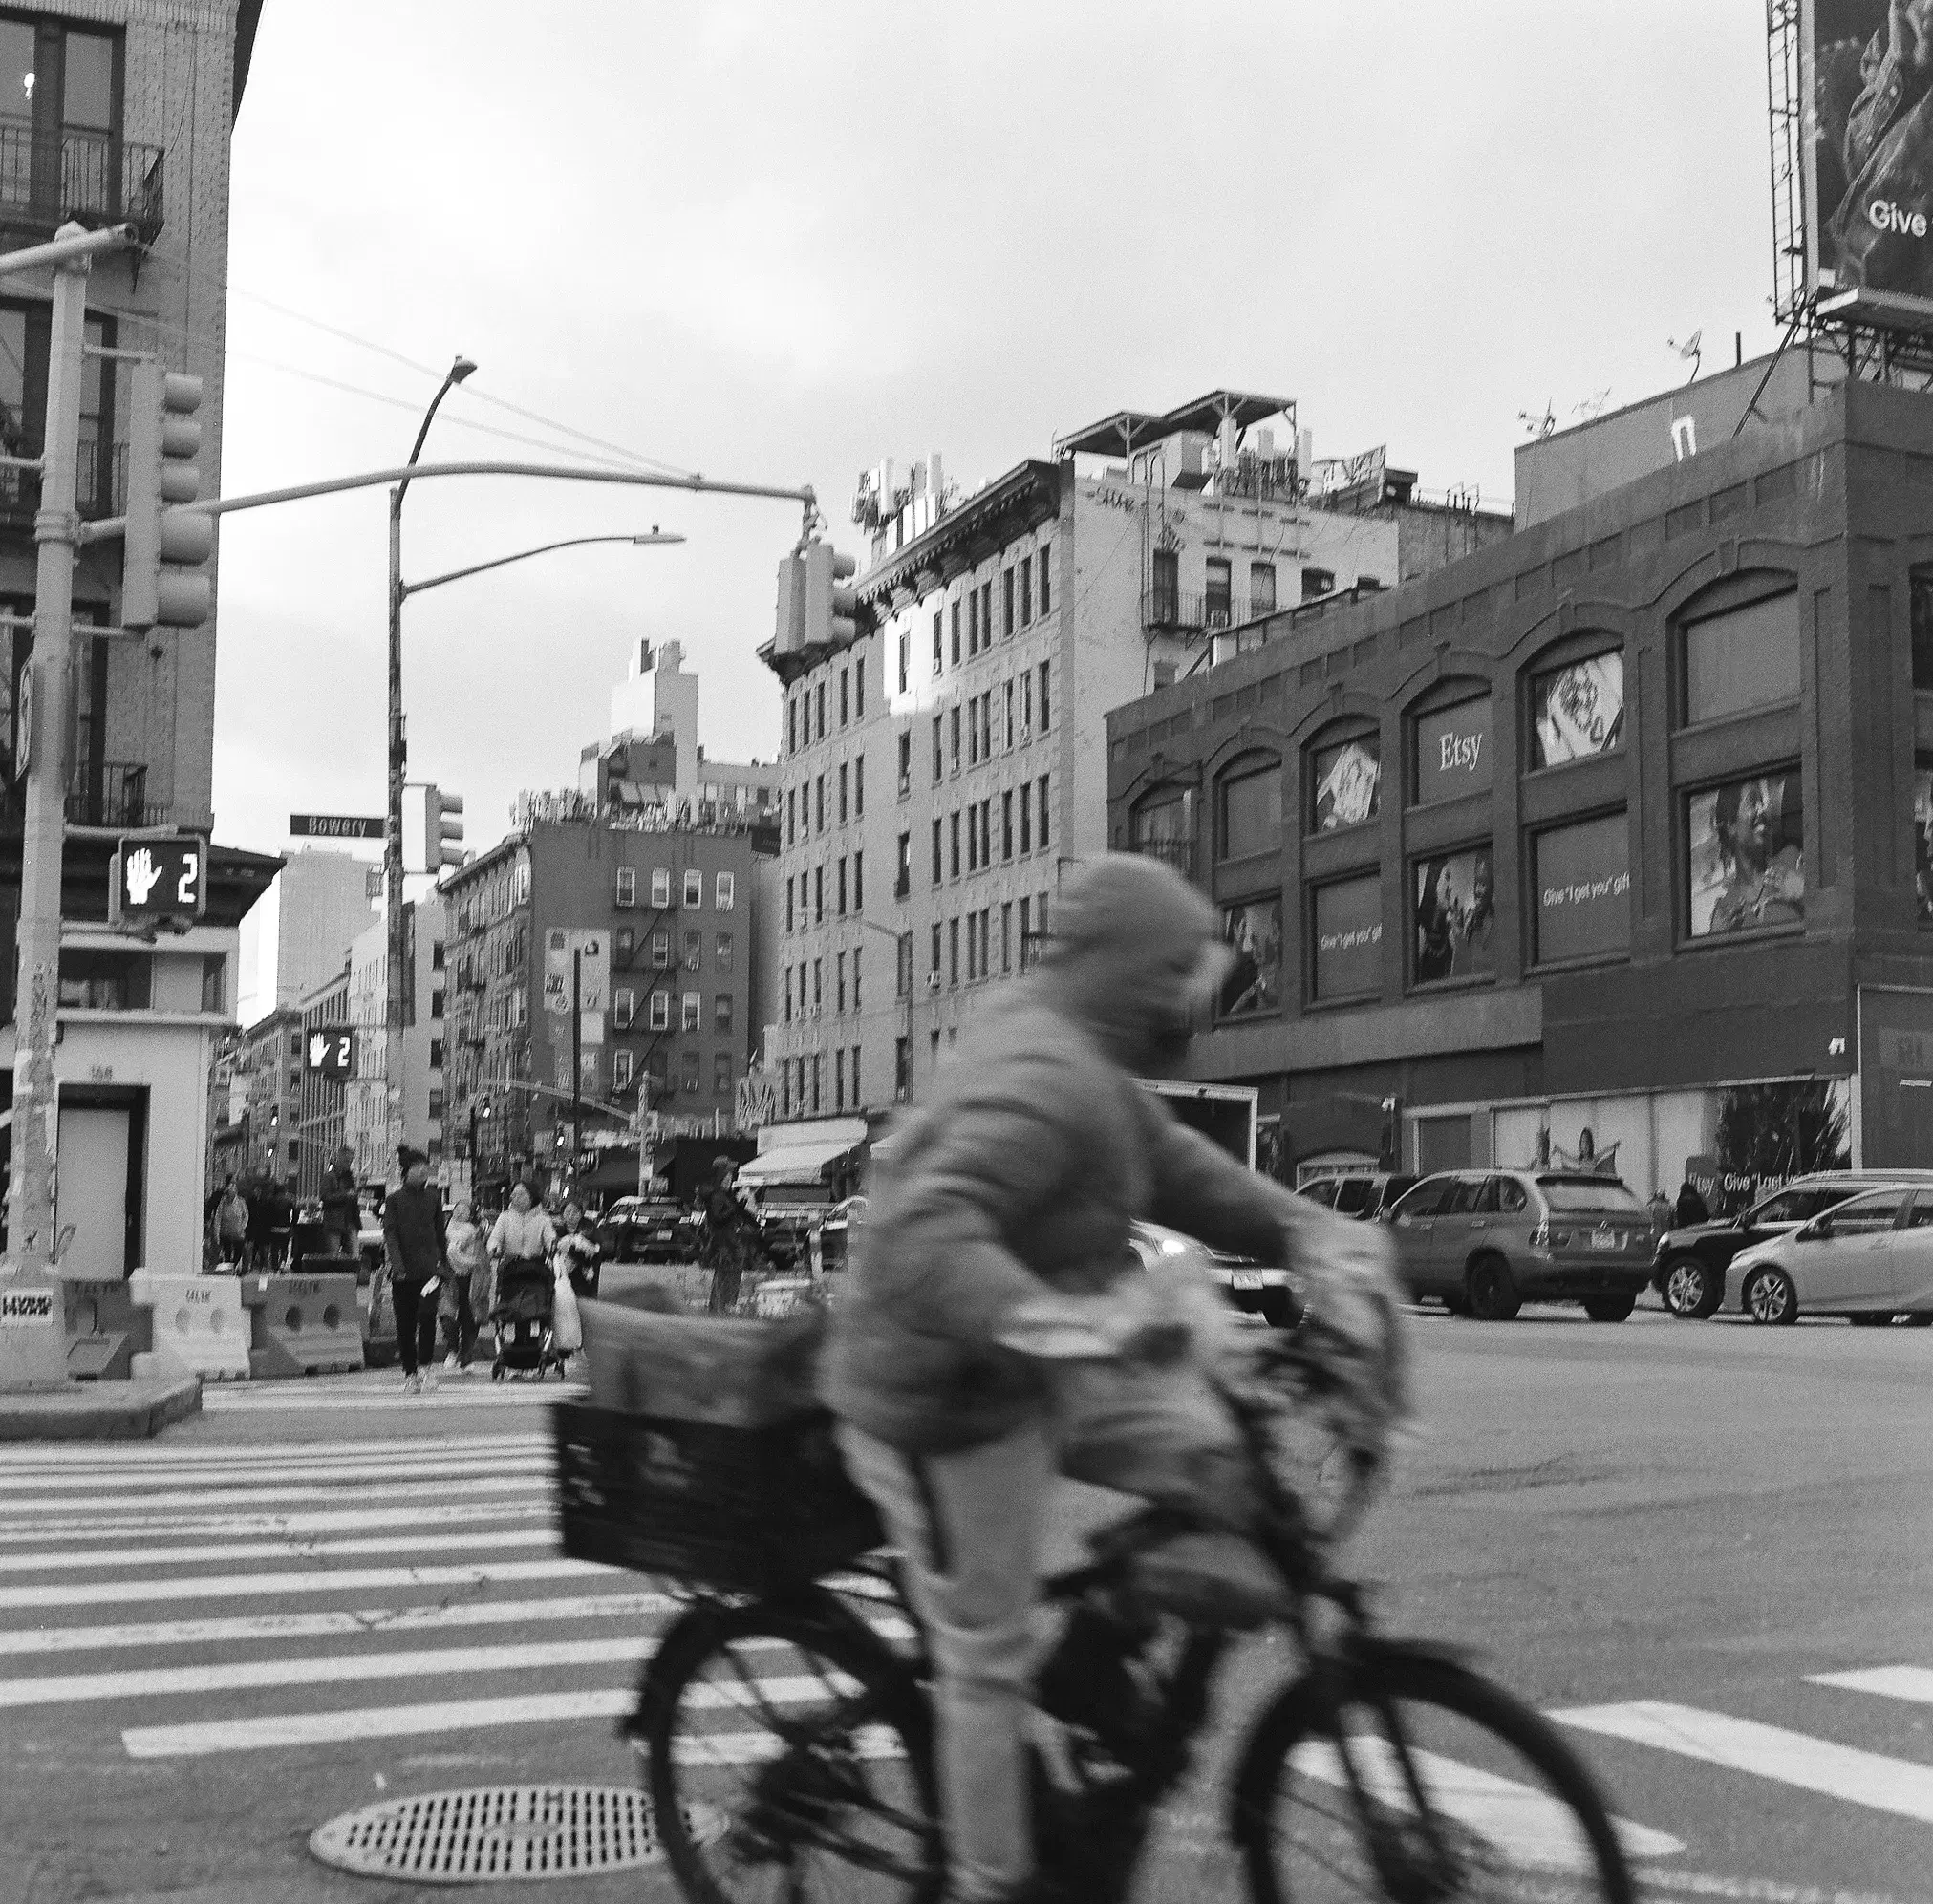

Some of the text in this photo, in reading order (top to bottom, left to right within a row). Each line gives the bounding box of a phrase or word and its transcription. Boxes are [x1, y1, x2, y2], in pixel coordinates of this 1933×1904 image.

[1868, 199, 1927, 238] Give
[1438, 731, 1483, 772] Etsy
[308, 816, 367, 838] Bowery
[178, 853, 198, 904] 2
[1543, 888, 1565, 907] Give
[337, 1036, 351, 1067] 2
[1724, 1172, 1750, 1192] Give
